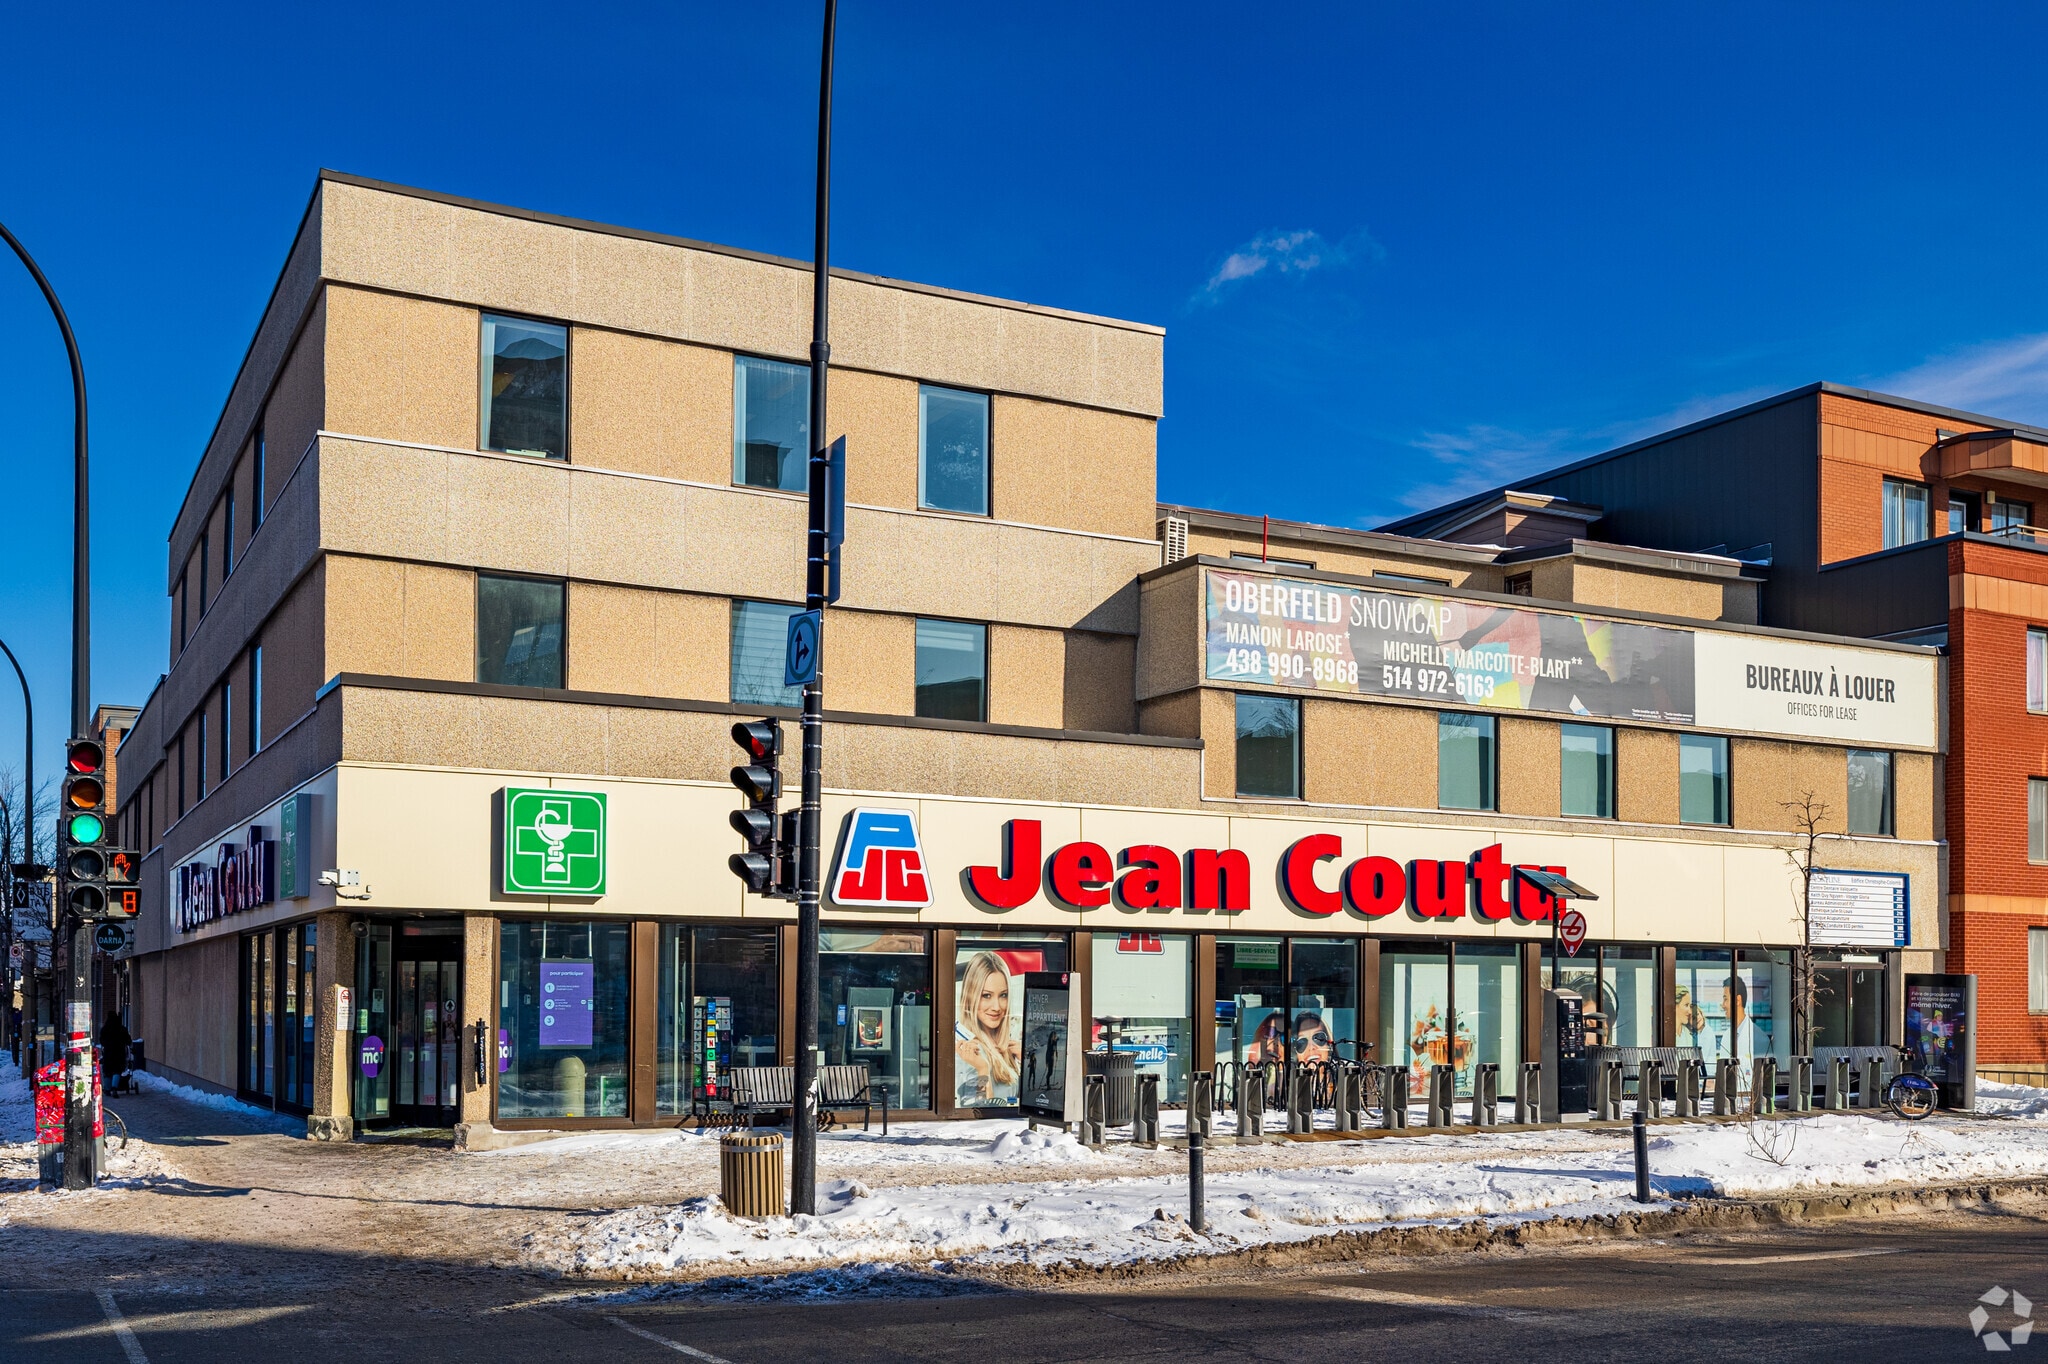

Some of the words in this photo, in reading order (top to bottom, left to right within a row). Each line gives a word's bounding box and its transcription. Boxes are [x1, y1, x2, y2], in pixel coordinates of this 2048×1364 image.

[1225, 580, 1342, 623] OBERFELD
[1350, 595, 1452, 637] SNOWCAP
[1226, 621, 1282, 647] MANON
[1226, 648, 1262, 674] 438
[1268, 652, 1359, 685] 990-8968
[1383, 640, 1450, 667] MICHELLE
[1382, 665, 1413, 690] 514
[1417, 668, 1495, 698] 972-6163
[1746, 664, 1824, 696] BUREAUX
[1829, 666, 1840, 698] À
[1845, 674, 1896, 703] LOUER
[1787, 702, 1818, 718] OFFICES
[1819, 704, 1834, 719] FOR
[1835, 706, 1858, 721] LEASE
[965, 818, 1251, 912] Jean
[1279, 833, 1568, 922] Coutu
[123, 891, 136, 913] 8
[1236, 947, 1277, 955] LIBRE-SERVICE
[1027, 1012, 1066, 1022] APPARTIENT
